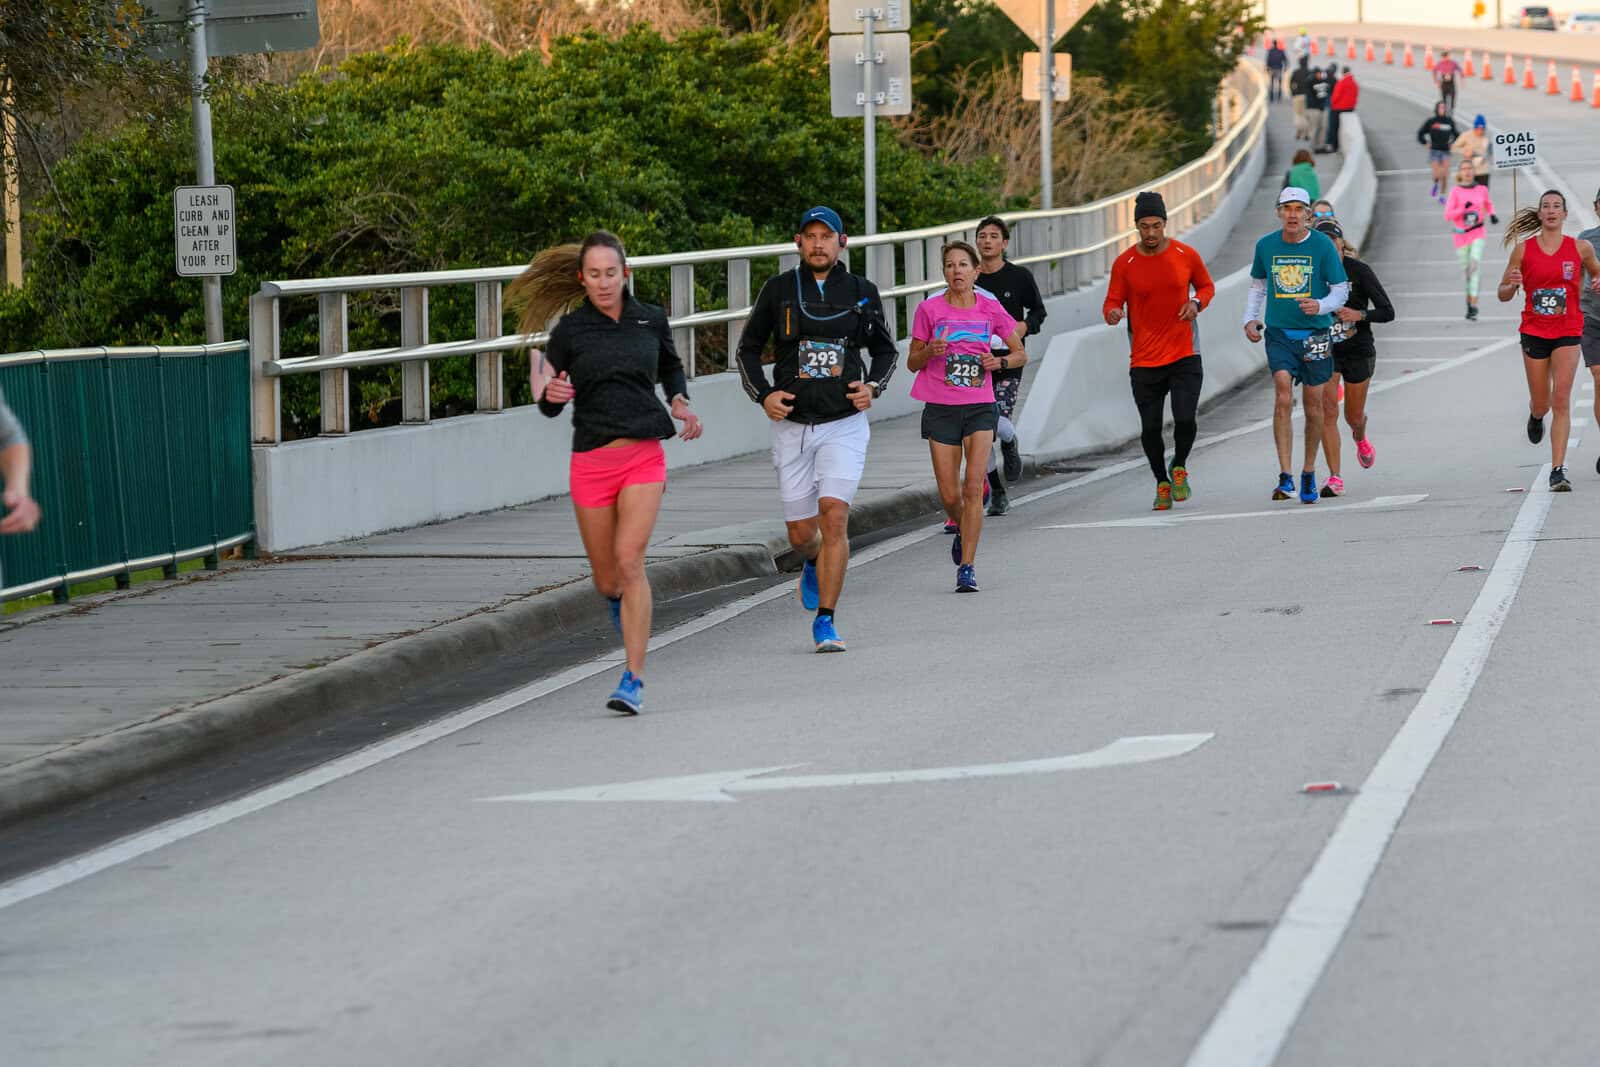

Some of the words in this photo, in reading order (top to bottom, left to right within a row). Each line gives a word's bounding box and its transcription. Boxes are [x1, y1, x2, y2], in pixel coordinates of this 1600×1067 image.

[1496, 132, 1534, 144] GOAL
[1505, 144, 1536, 156] 1:50
[190, 195, 218, 206] LEASH
[180, 210, 202, 222] CURB
[212, 210, 230, 220] AND
[181, 226, 208, 236] CLEAN
[217, 224, 229, 236] UP
[192, 240, 220, 251] AFTER
[182, 256, 206, 266] YOUR
[214, 254, 230, 266] PET
[1541, 296, 1557, 307] 56
[1310, 342, 1328, 354] 257
[808, 350, 838, 366] 293
[952, 364, 980, 377] 228
